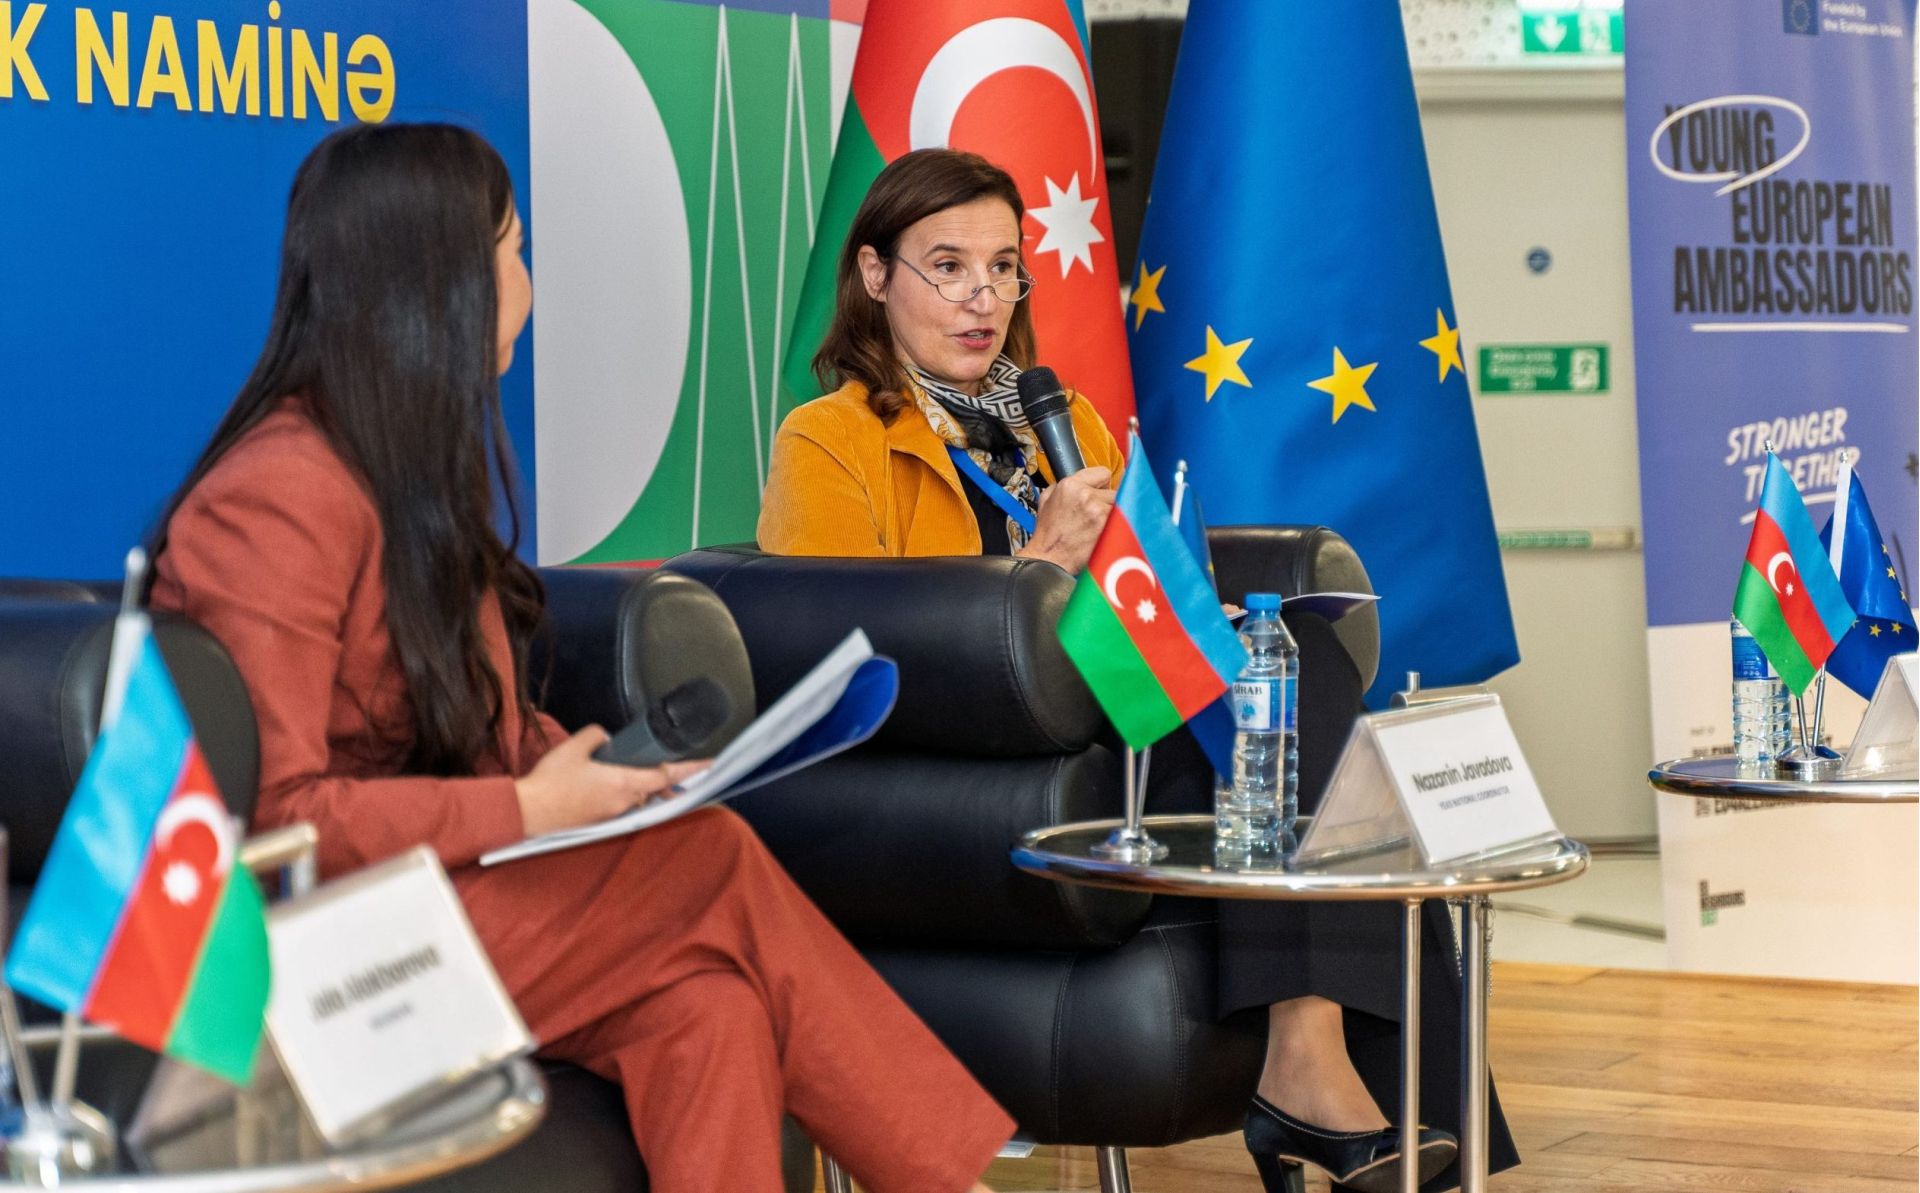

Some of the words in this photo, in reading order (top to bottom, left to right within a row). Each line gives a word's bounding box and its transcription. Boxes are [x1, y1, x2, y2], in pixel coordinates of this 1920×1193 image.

[0, 1, 50, 101] K
[75, 0, 396, 124] NAMİNƏ
[1665, 105, 1776, 175] YOUNG
[1732, 179, 1893, 246] EUROPEAN
[1674, 246, 1912, 316] AMBASSADORS
[1725, 407, 1848, 465] STRONGER
[1412, 763, 1462, 792] Nazanin
[1461, 756, 1513, 781] Javadova
